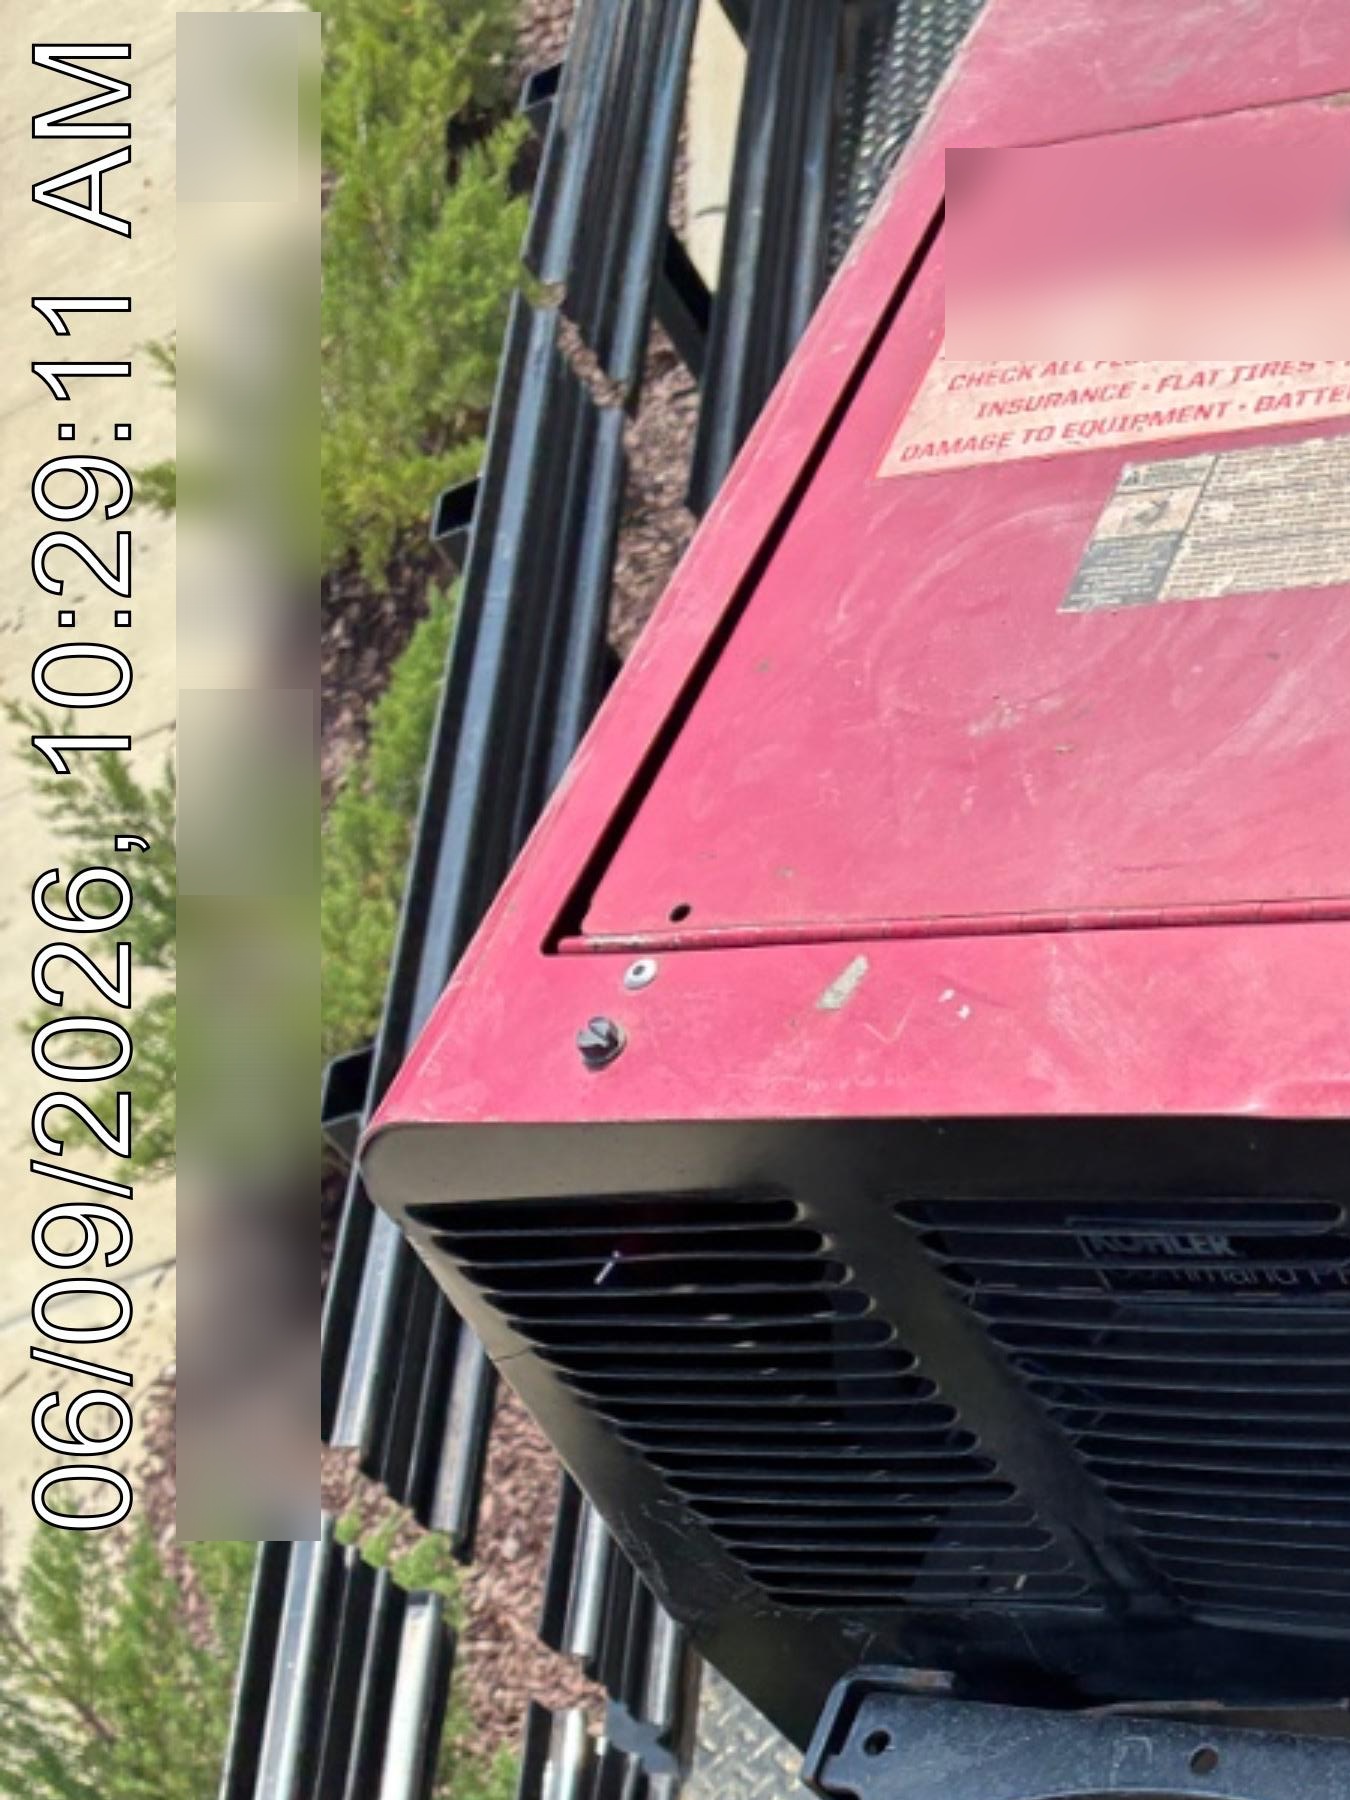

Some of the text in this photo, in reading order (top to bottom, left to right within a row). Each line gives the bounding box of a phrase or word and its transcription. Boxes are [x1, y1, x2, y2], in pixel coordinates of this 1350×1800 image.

[947, 364, 1034, 392] CHECK
[975, 361, 1315, 420] INSURANCE FLAT TIRES
[900, 430, 1014, 463] DAMAGE
[1022, 425, 1054, 442] TO
[1061, 401, 1230, 440] EQUIPMENT
